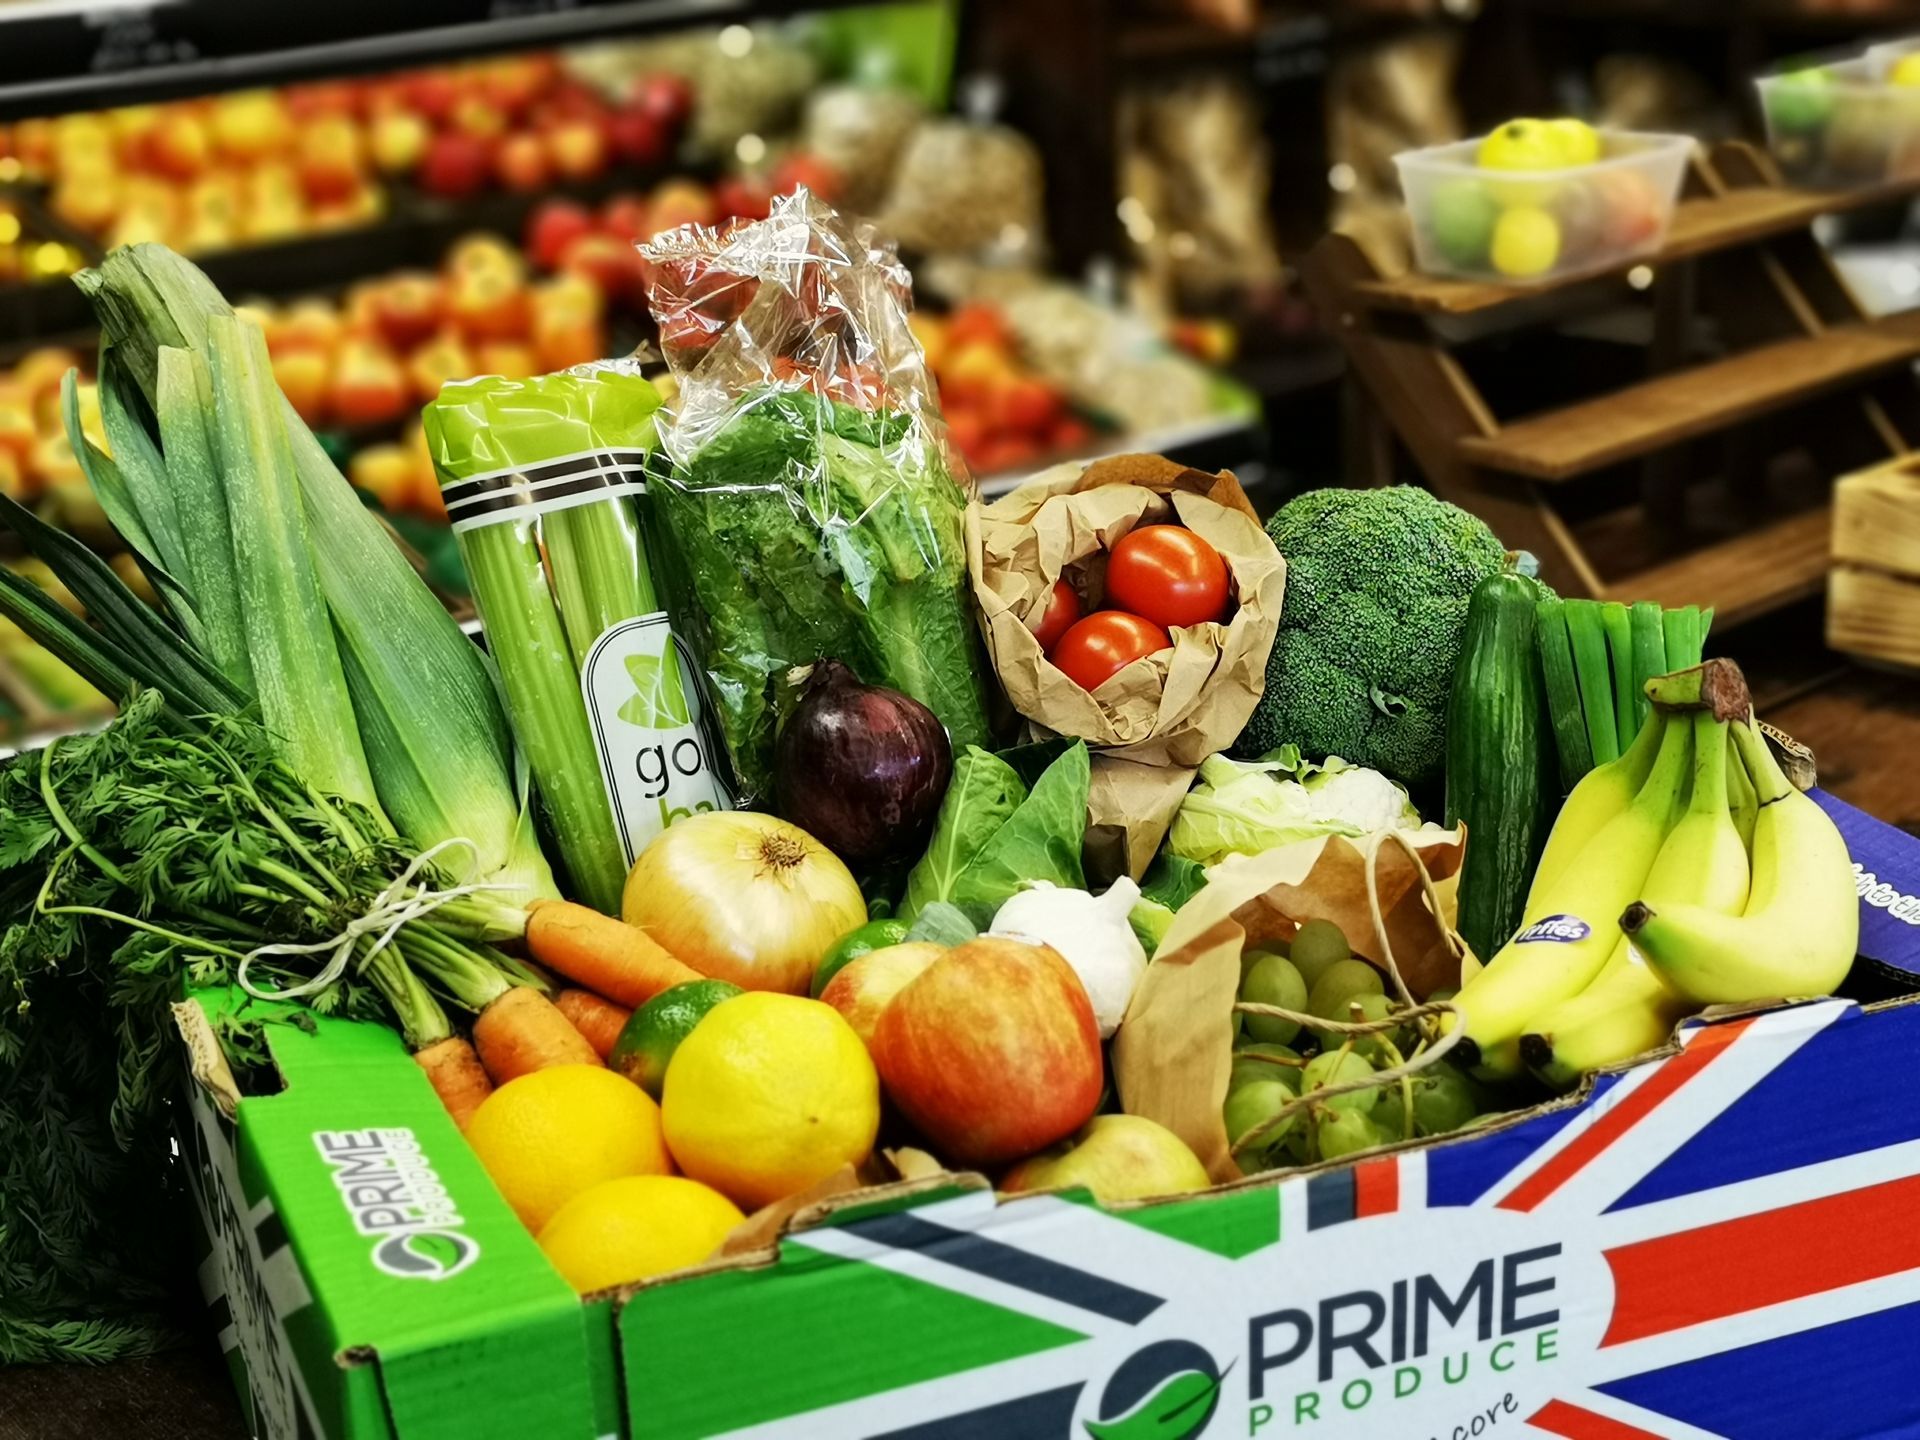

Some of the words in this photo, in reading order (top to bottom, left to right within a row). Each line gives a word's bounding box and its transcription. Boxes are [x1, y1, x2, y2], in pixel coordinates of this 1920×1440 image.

[319, 1130, 425, 1230] PRIME
[1248, 1242, 1563, 1401] PRIME
[1248, 1328, 1560, 1438] PRODUCE
[1451, 1391, 1520, 1440] core
